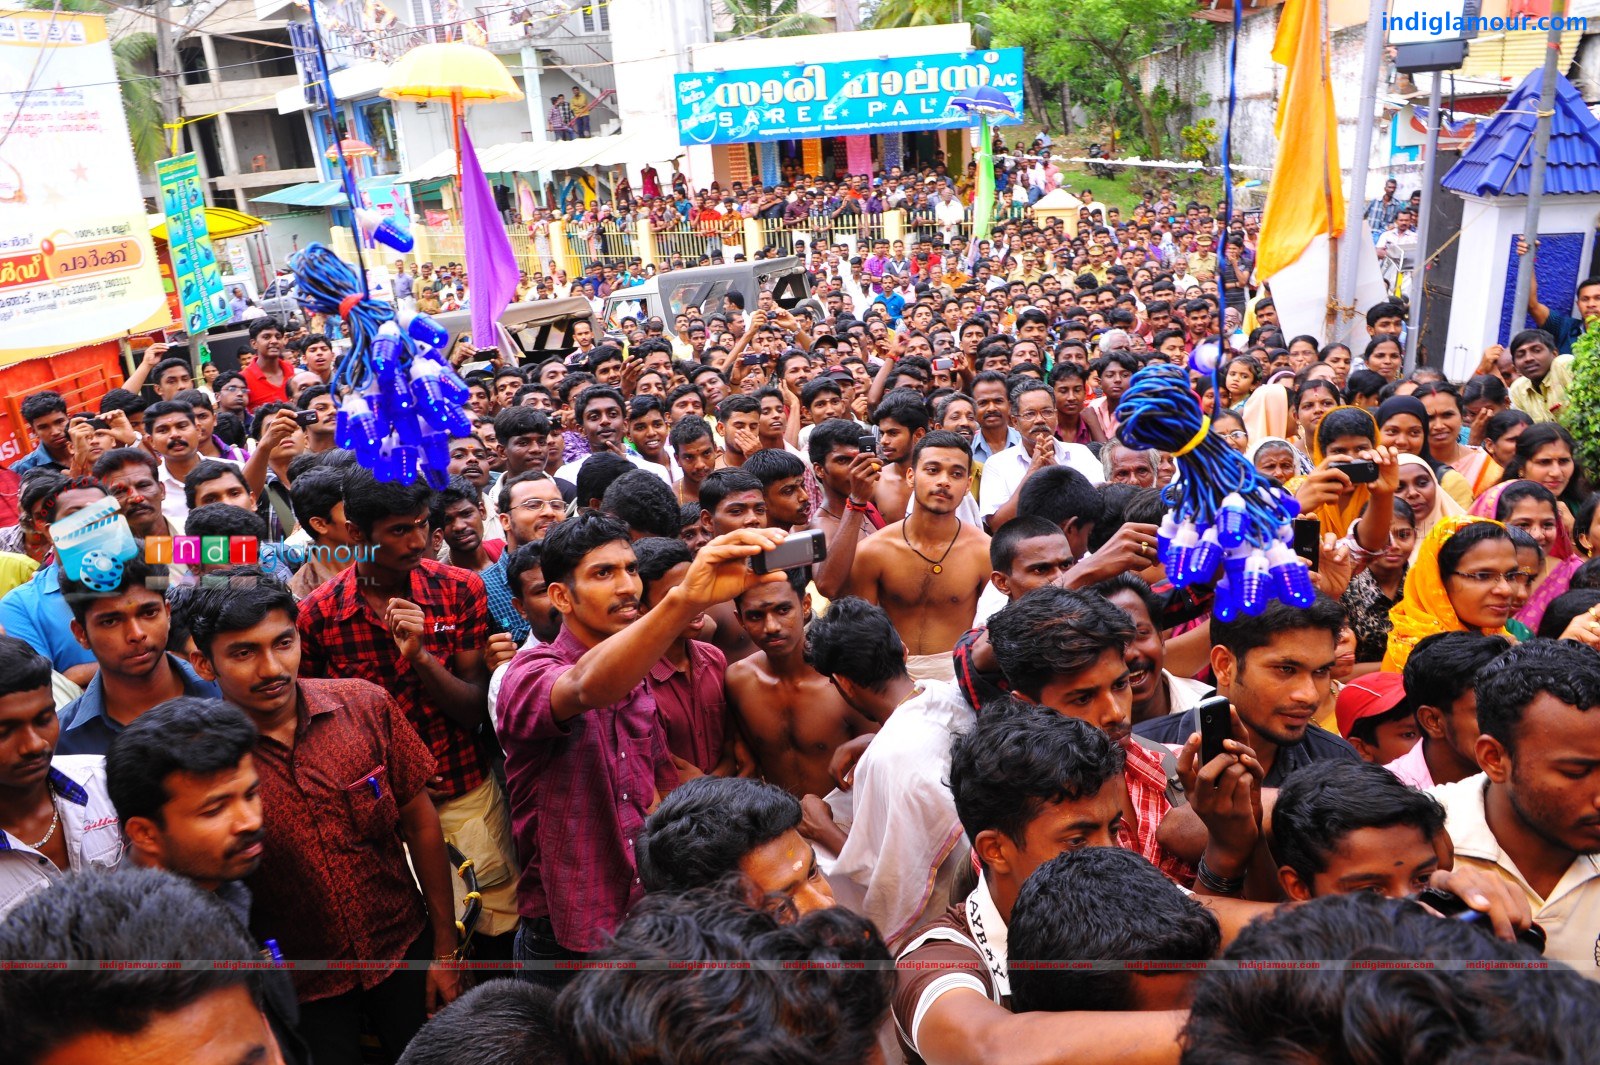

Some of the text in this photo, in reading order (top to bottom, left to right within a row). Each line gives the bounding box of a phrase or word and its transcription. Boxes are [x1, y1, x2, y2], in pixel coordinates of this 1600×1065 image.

[714, 64, 829, 108] സാരി
[992, 72, 1018, 87] A/C
[718, 104, 838, 128] SAREE
